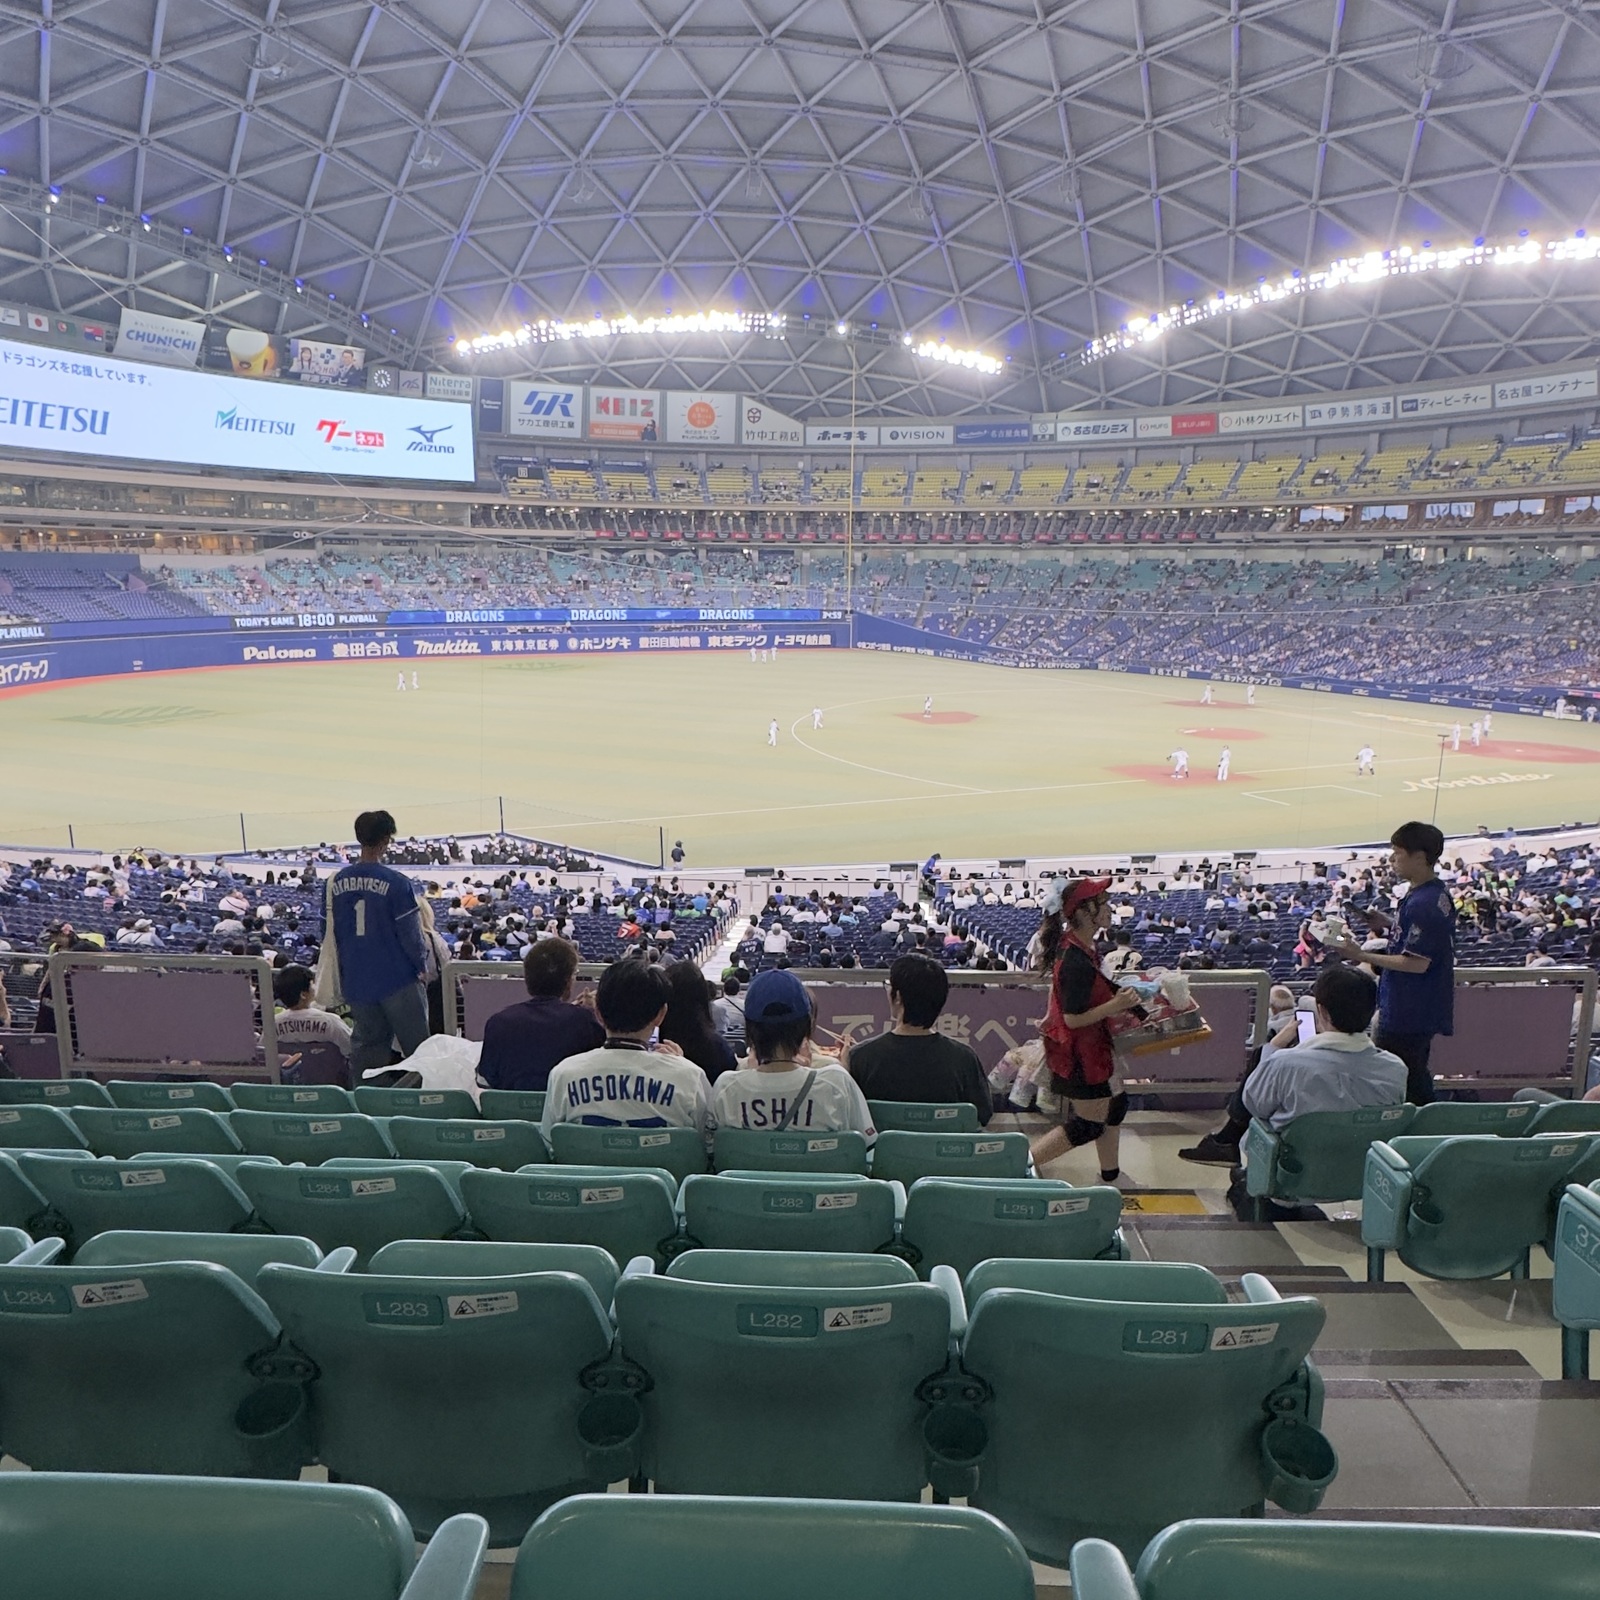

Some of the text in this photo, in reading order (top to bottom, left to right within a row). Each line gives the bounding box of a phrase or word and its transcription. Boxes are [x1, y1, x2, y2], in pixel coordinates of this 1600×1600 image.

[3, 351, 152, 386] ドラゴンズを応援しています。
[429, 376, 471, 389] Niterra
[1498, 379, 1595, 400] 名古屋コンテナー
[1327, 402, 1391, 419] 伊勢湾海運
[1235, 412, 1299, 427] 小林クリエイト
[745, 429, 800, 442] 竹中工務店
[902, 430, 945, 440] VISION
[1073, 423, 1129, 435] 名古屋シミズ
[406, 441, 455, 454] MIZUNO
[235, 613, 378, 628] TODAY'S GAME 18:00 PLAYBALL
[446, 610, 505, 622] DRAGONS
[571, 609, 628, 621] DRAGONS
[699, 609, 755, 620] DRAGONS
[413, 639, 482, 655] Makita
[491, 638, 560, 652] 東海東京証券
[579, 637, 632, 650] ホシザキ
[707, 635, 767, 647] 東芝テック
[243, 645, 317, 661] Paloma
[332, 641, 399, 658] 豊田合成
[332, 876, 390, 896] OKABAYASHI
[353, 899, 366, 937] 1
[567, 1074, 675, 1108] HOSOKAWA
[741, 1098, 813, 1127] ISHII
[307, 1182, 340, 1194] L284
[537, 1191, 570, 1202] L283
[770, 1197, 804, 1208] L282
[1002, 1203, 1034, 1214] L281
[3, 1290, 56, 1304] L284
[376, 1301, 429, 1317] L283
[750, 1312, 803, 1327] L282
[1136, 1329, 1188, 1345] L281
